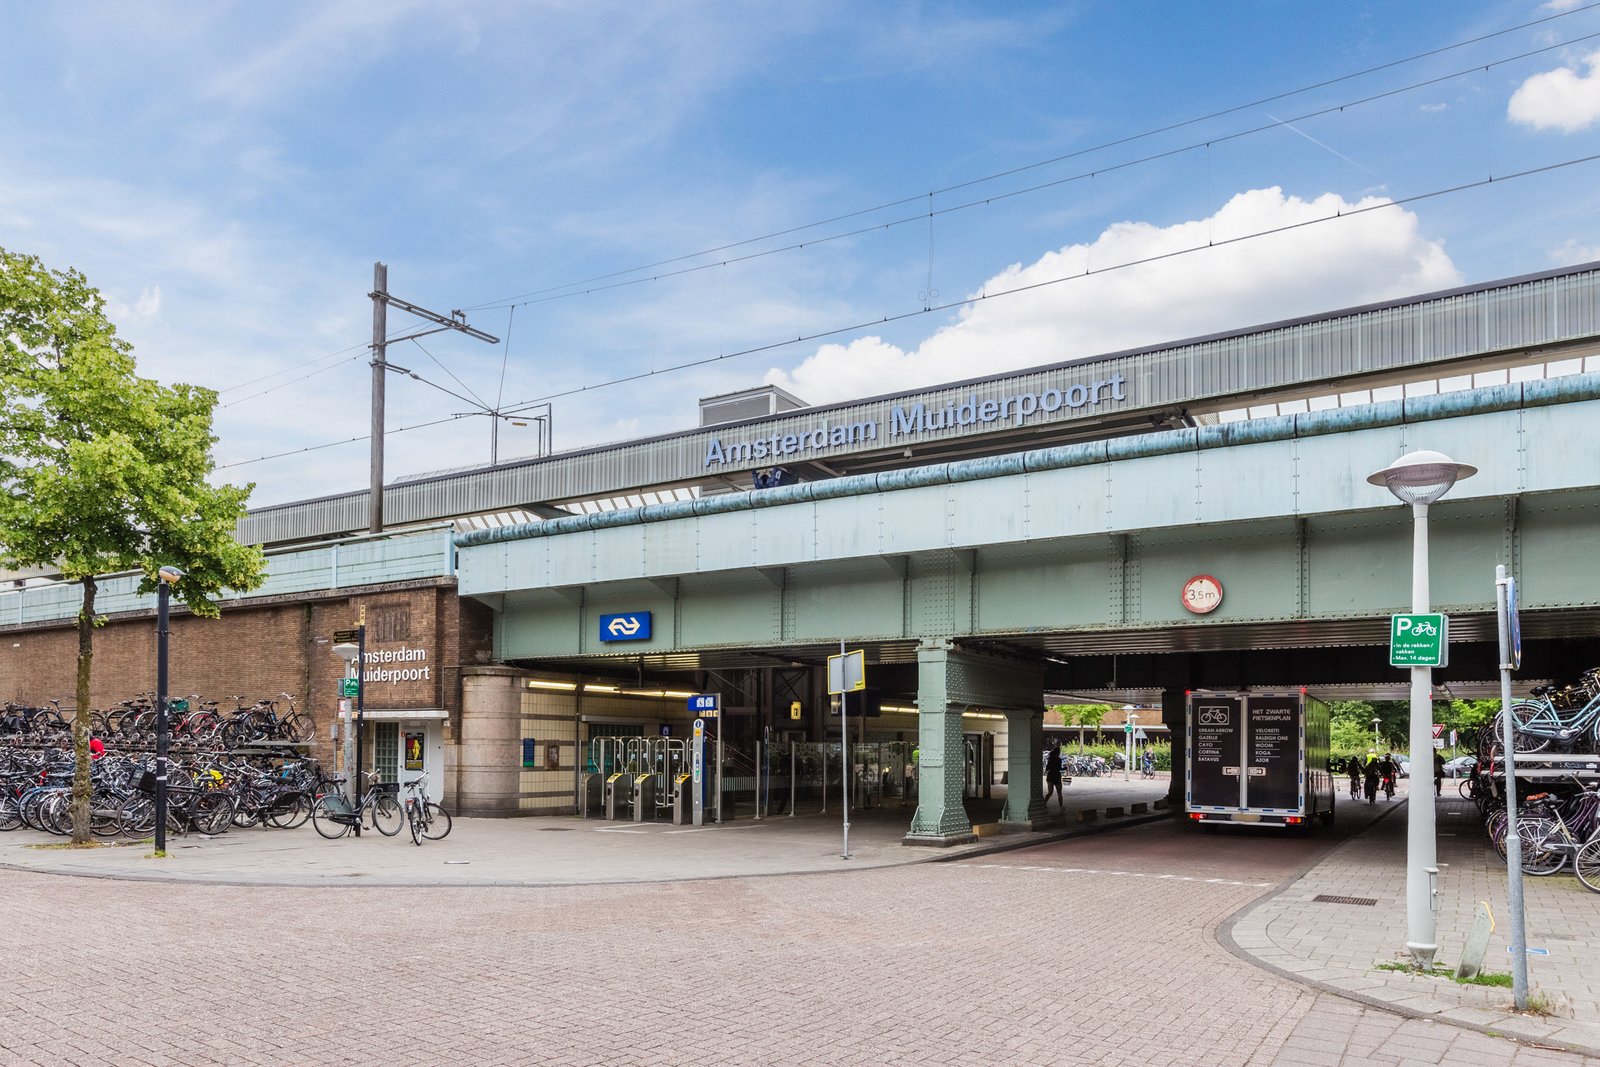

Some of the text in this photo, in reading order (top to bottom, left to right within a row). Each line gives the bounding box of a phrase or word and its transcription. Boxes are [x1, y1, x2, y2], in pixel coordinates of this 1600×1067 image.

[704, 372, 1126, 467] Amsterdam Muiderpoort
[1396, 618, 1412, 636] P
[351, 646, 426, 664] Amsterdam
[350, 666, 430, 685] Muiderpoort
